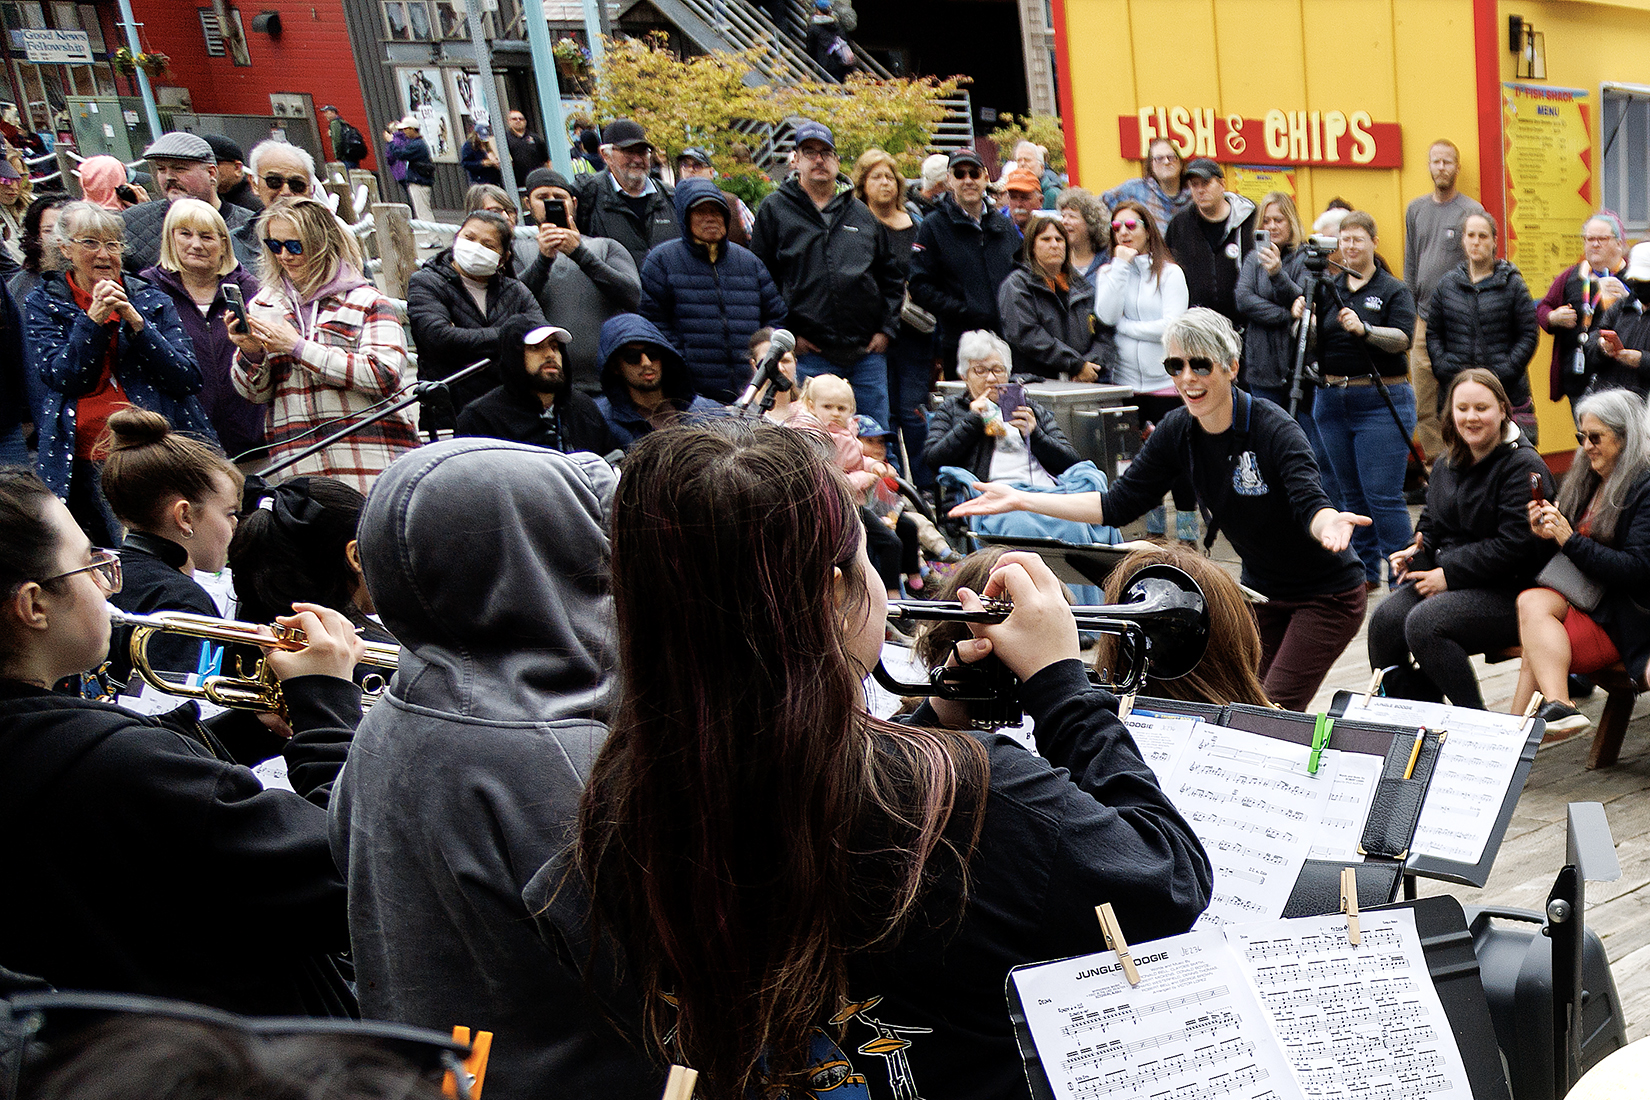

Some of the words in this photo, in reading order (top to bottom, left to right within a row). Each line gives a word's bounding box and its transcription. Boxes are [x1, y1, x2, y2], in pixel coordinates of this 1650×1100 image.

[24, 30, 53, 40] Good
[56, 31, 87, 41] News
[27, 42, 85, 52] Fellowship
[1525, 87, 1544, 99] FISH
[1546, 90, 1574, 102] SHACK
[1537, 105, 1559, 116] MENU
[1139, 106, 1217, 158] FISH
[1226, 114, 1246, 154] &
[1265, 109, 1377, 163] CHIPS
[1075, 962, 1123, 981] JUNGLE
[1133, 951, 1169, 967] OOGIE
